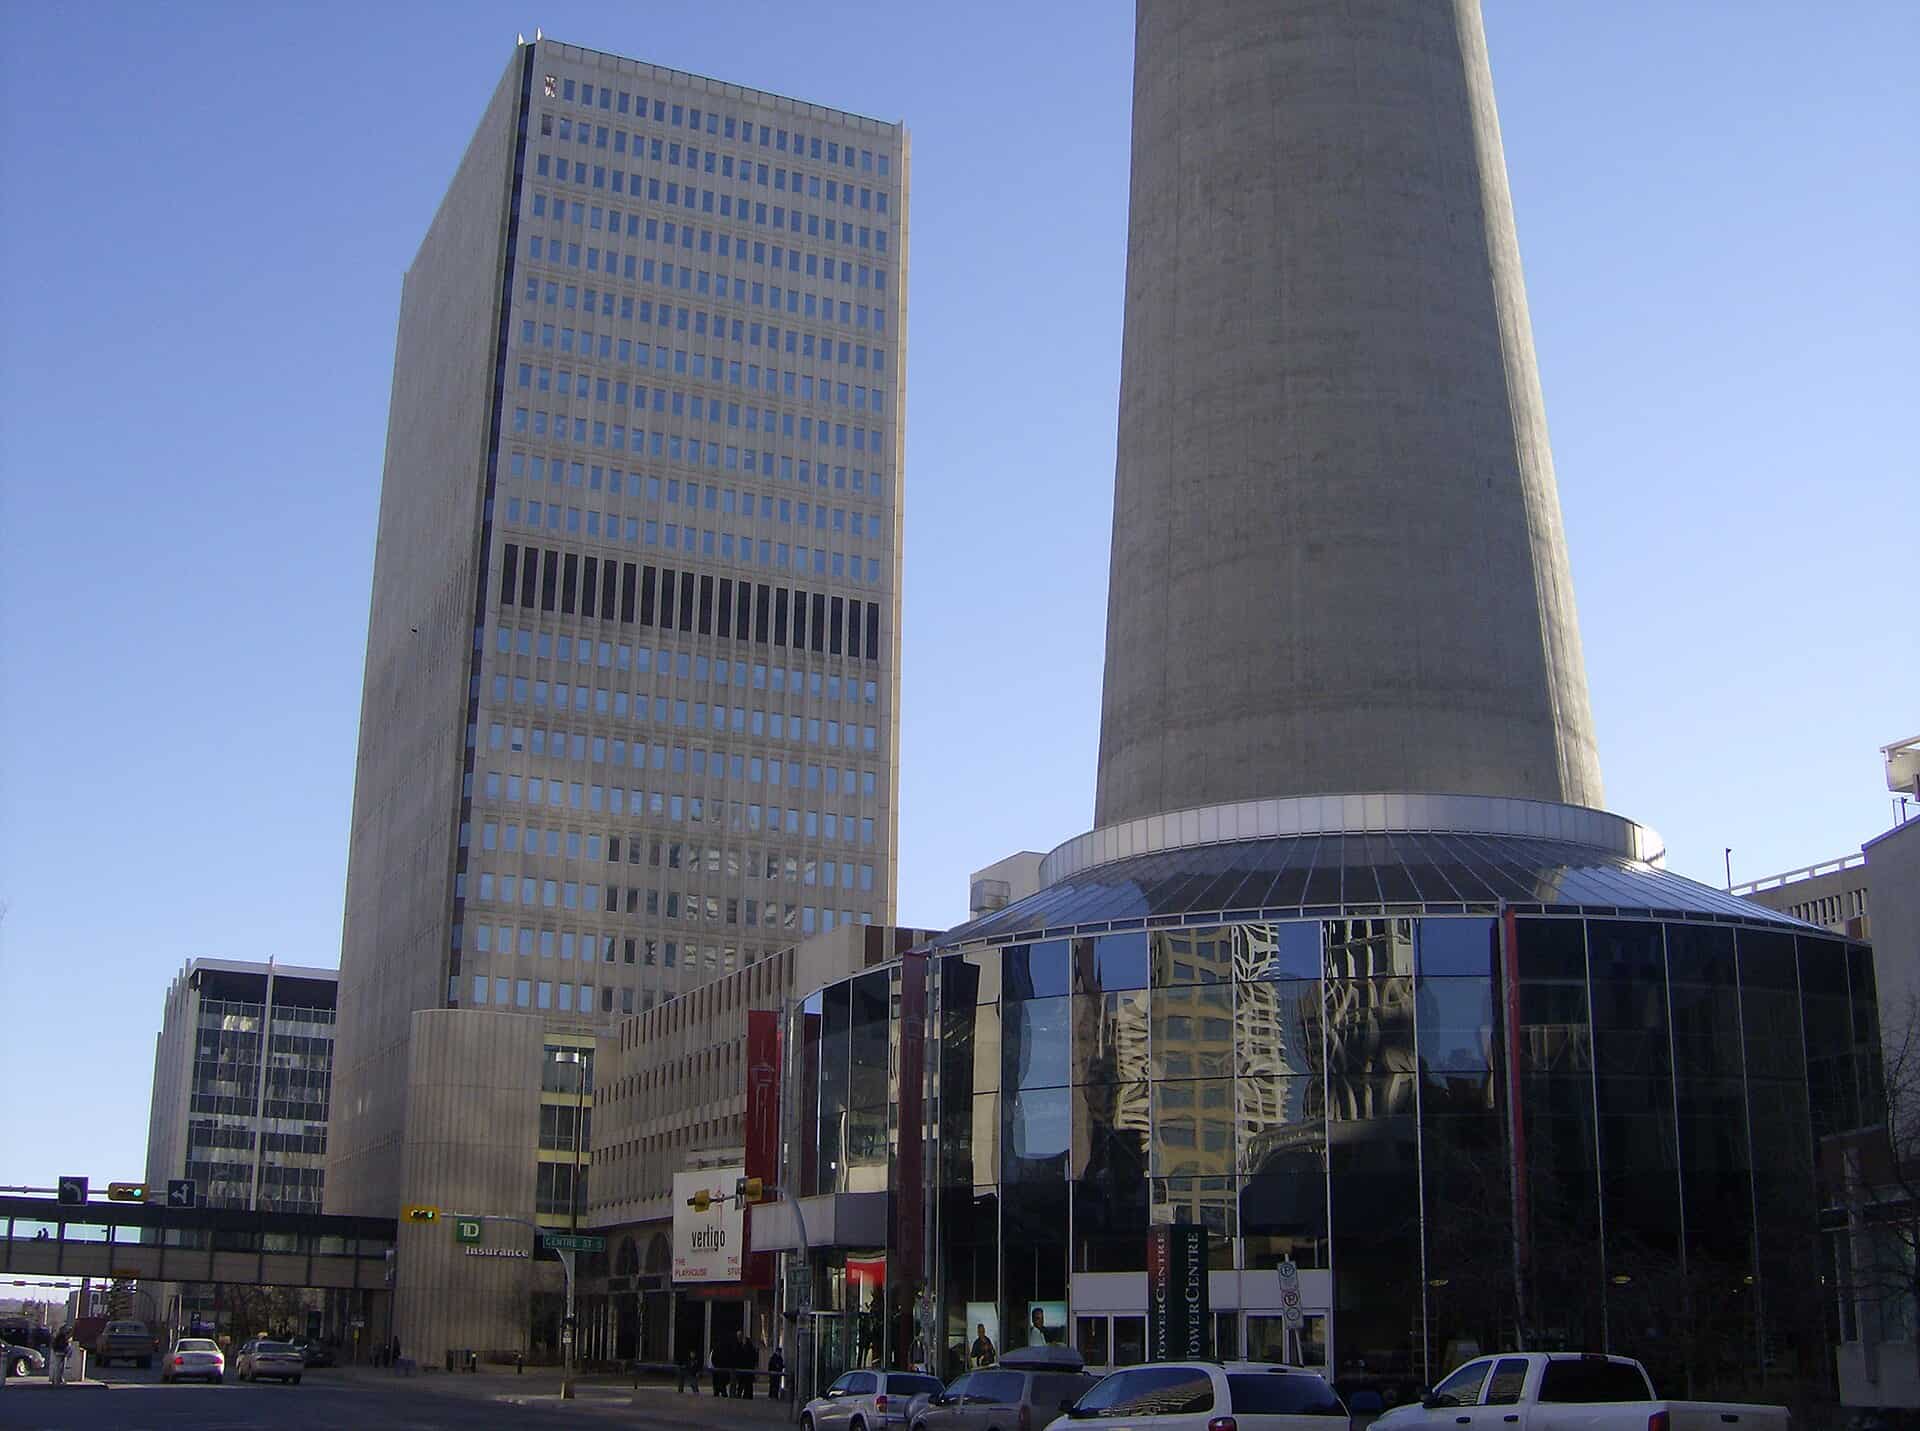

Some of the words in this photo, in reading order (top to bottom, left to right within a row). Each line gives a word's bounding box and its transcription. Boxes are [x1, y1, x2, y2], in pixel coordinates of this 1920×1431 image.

[459, 1222, 480, 1238] TD
[545, 1237, 576, 1248] CENTRE
[691, 1224, 726, 1252] vertigo
[465, 1245, 529, 1258] Insurance
